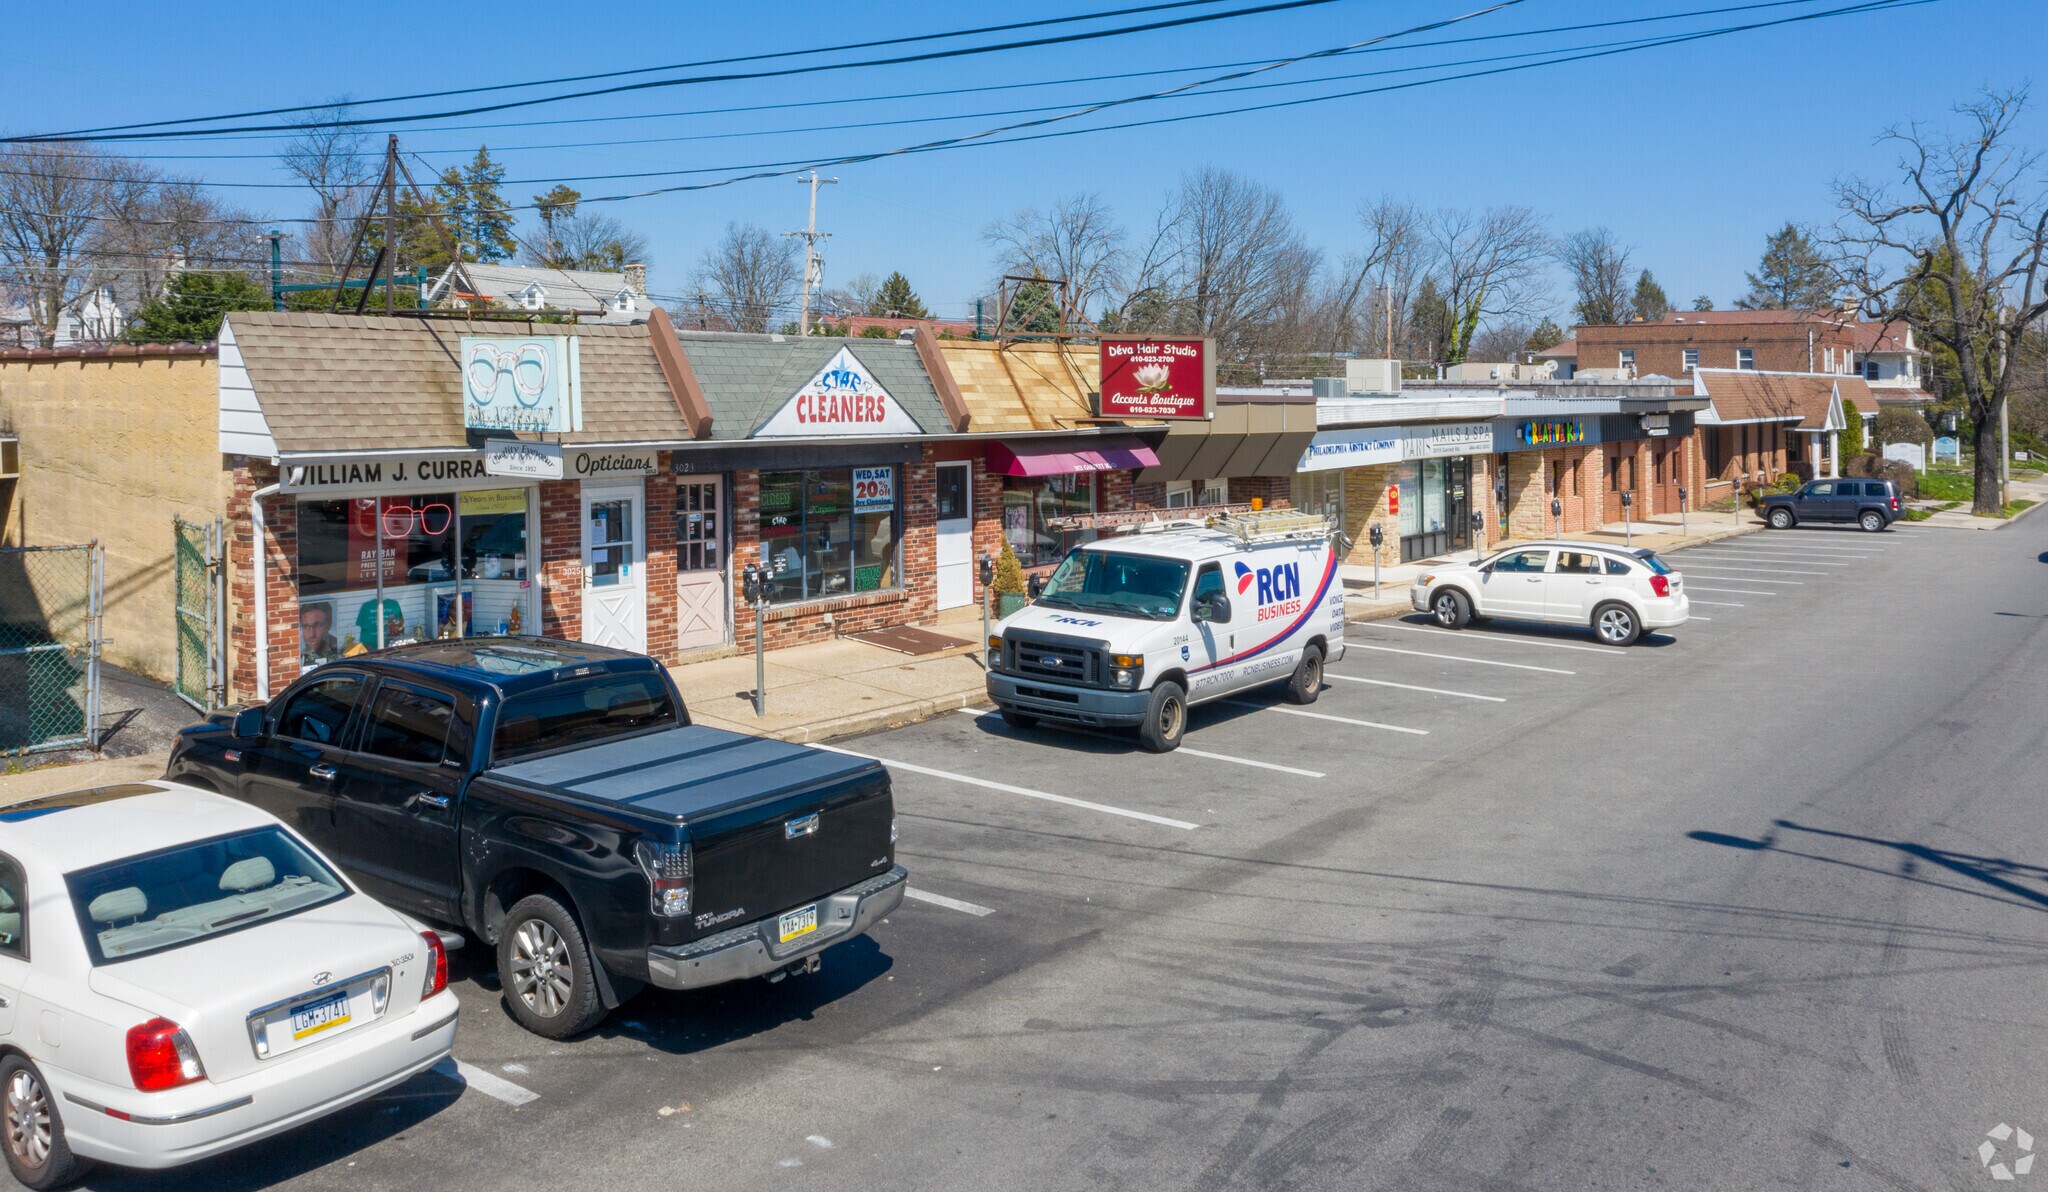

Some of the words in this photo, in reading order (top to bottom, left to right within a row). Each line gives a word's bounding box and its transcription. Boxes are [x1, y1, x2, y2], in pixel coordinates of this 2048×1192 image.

[1108, 344, 1134, 357] Déva
[1137, 343, 1160, 354] Hair
[1163, 344, 1197, 357] Studio
[822, 370, 862, 392] STAR
[1111, 392, 1148, 404] Accents
[1150, 393, 1195, 408] Boutique
[796, 394, 886, 424] CLEANERS
[1129, 406, 1176, 414] 610-623-7030
[1432, 427, 1461, 442] NAILS
[1465, 426, 1469, 440] &
[1473, 425, 1490, 440] SPA
[1524, 422, 1565, 445] CREATIVE
[1566, 420, 1584, 443] KIDS
[1309, 444, 1347, 457] PHILADELPHIA
[1348, 442, 1373, 453] ABSTRACT
[1373, 439, 1396, 450] COMPANY
[521, 445, 556, 468] Eyewear
[392, 462, 408, 482] J.
[575, 452, 653, 476] Opticians
[524, 465, 537, 473] 1952
[674, 463, 695, 472] 3023
[761, 492, 790, 506] CLOSED
[562, 567, 581, 576] 3025
[1256, 562, 1300, 606] RCN
[1329, 594, 1344, 606] VOICE
[1257, 600, 1301, 622] BUSINESS
[1331, 608, 1344, 618] DATA
[1054, 617, 1104, 627] RCN
[1173, 635, 1189, 646] 20144
[695, 907, 746, 930] TUNDRA
